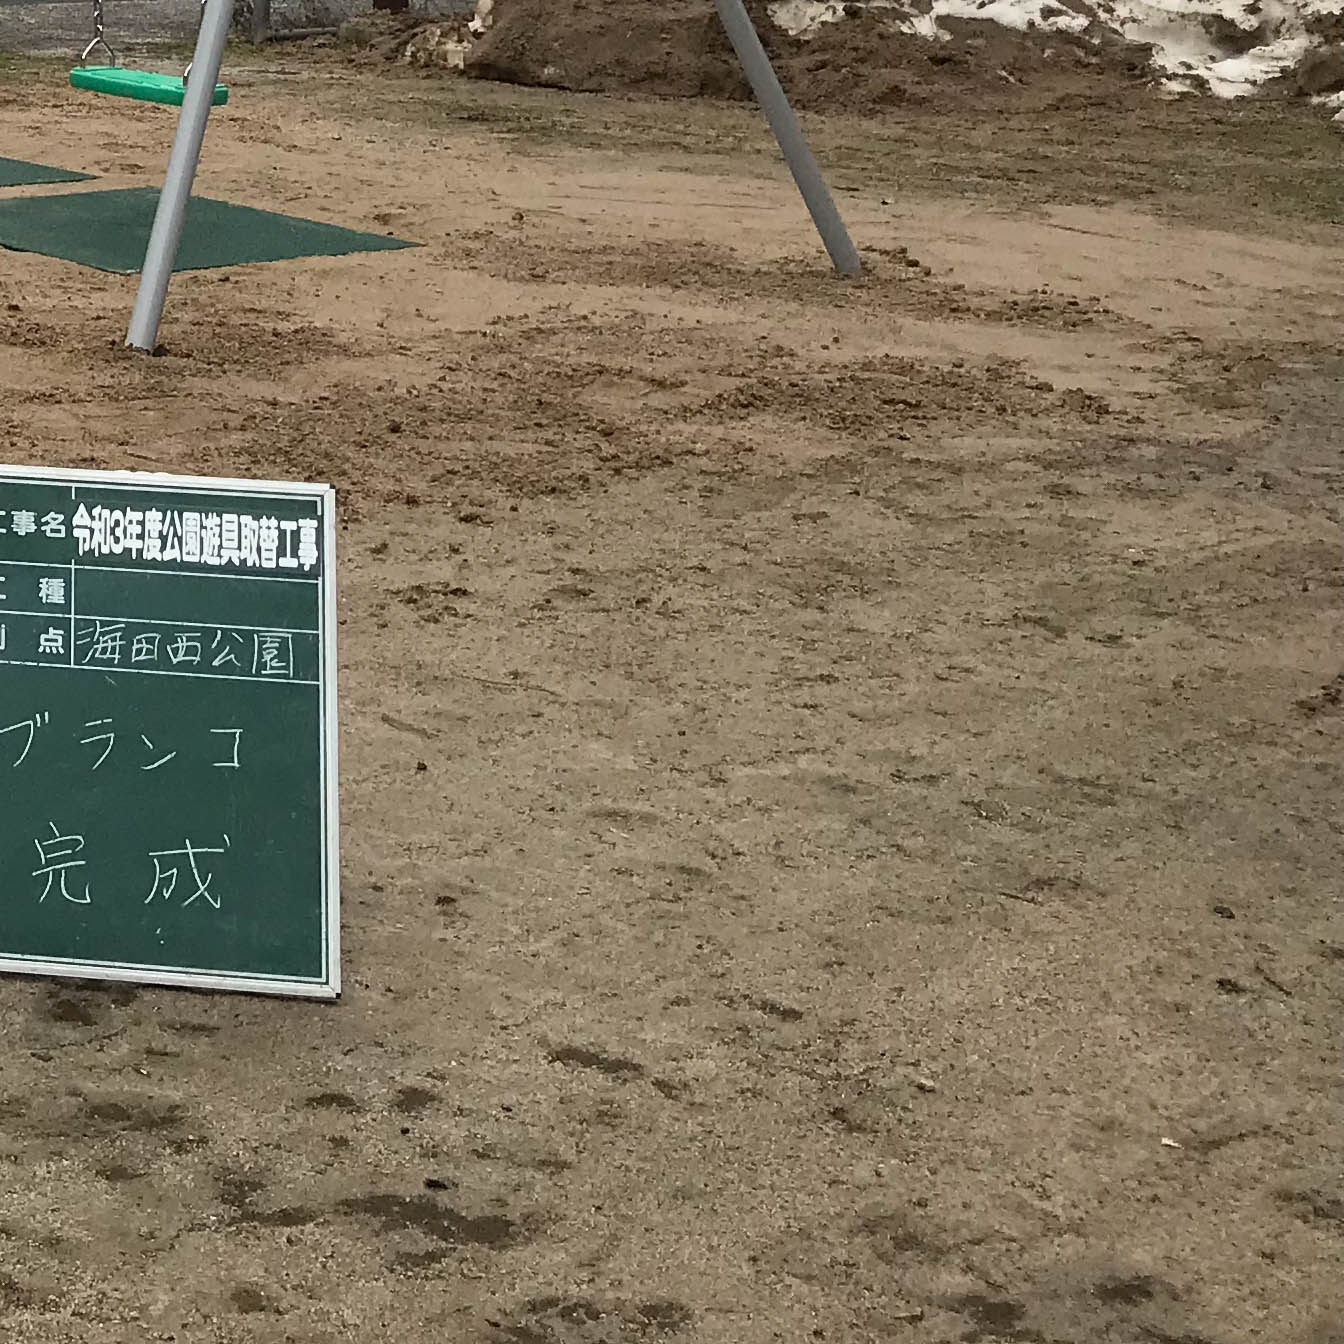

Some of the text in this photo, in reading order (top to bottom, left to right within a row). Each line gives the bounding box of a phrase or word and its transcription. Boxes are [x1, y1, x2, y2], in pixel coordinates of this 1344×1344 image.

[72, 502, 319, 571] 令和3年度公園遊具取替工事
[75, 620, 294, 678] 海田西公園
